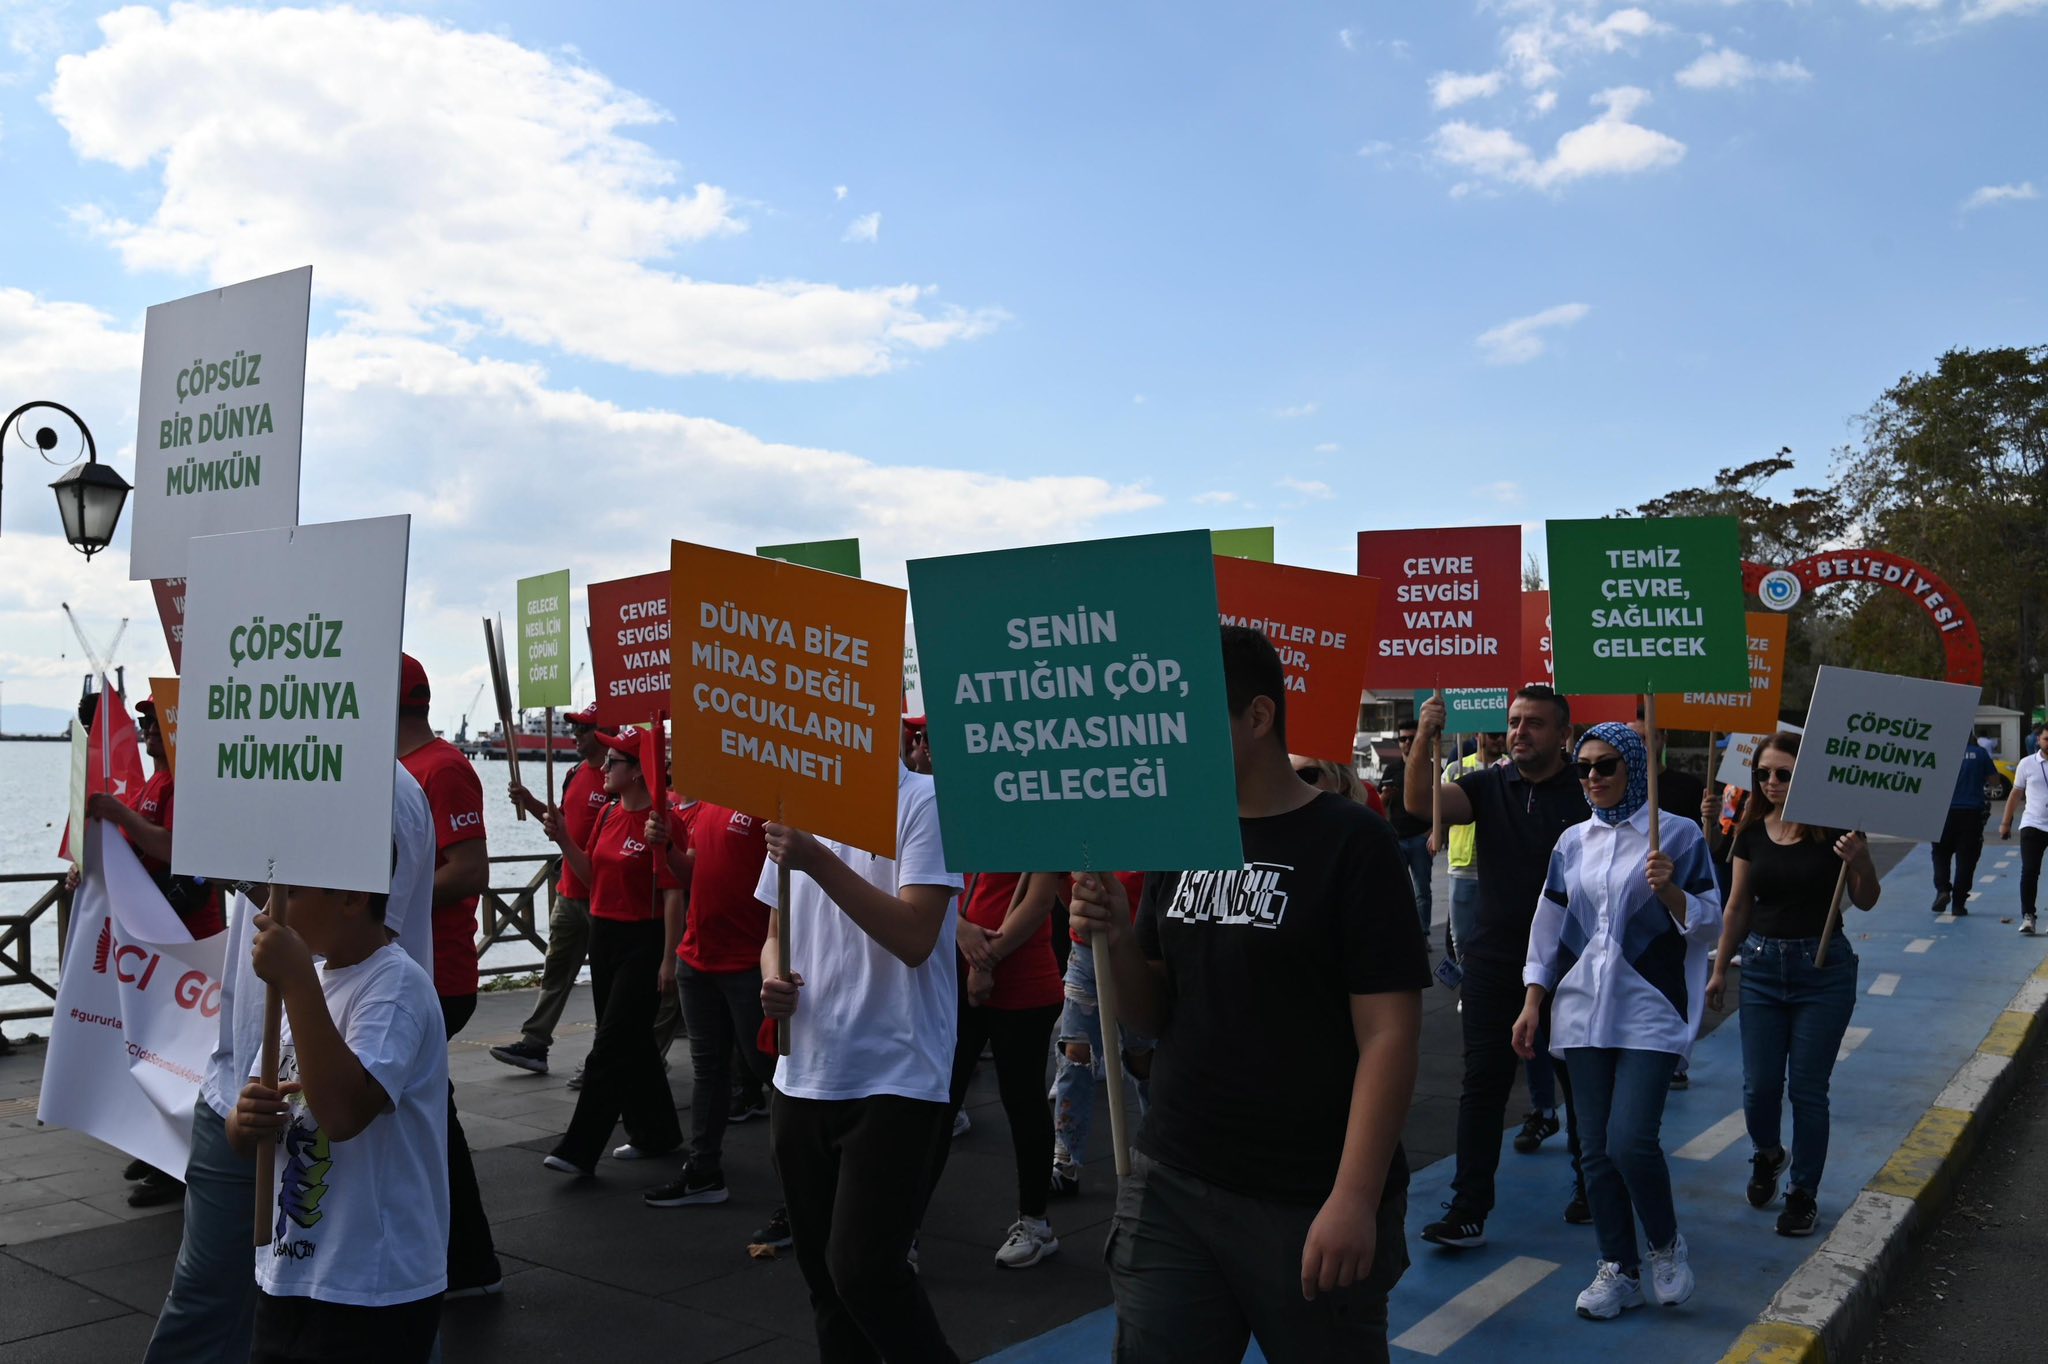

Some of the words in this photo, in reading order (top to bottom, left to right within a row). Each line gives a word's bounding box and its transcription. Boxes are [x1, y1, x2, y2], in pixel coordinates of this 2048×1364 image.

[176, 350, 261, 404] ÇÖPSÜZ
[160, 411, 193, 449] BİR
[198, 403, 273, 443] DÜNYA
[166, 450, 261, 496] MÜMKÜN
[1403, 557, 1473, 578] ÇEVRE
[1606, 545, 1681, 569] TEMİZ
[1397, 579, 1479, 602] SEVGİSİ
[1601, 578, 1690, 602] ÇEVRE,
[1817, 559, 1963, 632] BELEDİYESİ
[527, 596, 559, 615] GELECEK
[620, 599, 666, 623] ÇEVRE
[1591, 604, 1703, 628] SAĞLIKLI
[525, 619, 545, 638] NESİL
[617, 619, 671, 646] SEVGİSİ
[700, 601, 796, 649] DÜNYA
[805, 624, 869, 667] BİZE
[1007, 605, 1117, 650] SENİN
[1218, 613, 1316, 645] MARİTLER
[1320, 630, 1347, 649] DE
[1403, 611, 1473, 629] VATAN
[230, 613, 343, 668] ÇÖPSÜZ
[529, 639, 558, 661] ÇÖPÜNÜ
[1378, 634, 1498, 657] SEVGİSİDİR
[1593, 636, 1706, 658] GELECEK
[1746, 634, 1769, 651] İZE
[529, 664, 548, 683] ÇÖPE
[549, 664, 558, 680] AT
[623, 649, 670, 670] VATAN
[609, 671, 671, 697] SEVGİSİD
[692, 640, 777, 685] MİRAS
[785, 663, 876, 717] DEĞİL,
[954, 659, 1094, 705] ATTIĞIN
[1104, 653, 1189, 701] ÇÖP,
[208, 676, 252, 720] BİR
[259, 674, 360, 720] DÜNYA
[1453, 696, 1508, 711] GELECEĞİ
[1683, 691, 1752, 708] EMANETİ
[693, 683, 873, 753] ÇOCUKLARIN
[1847, 712, 1932, 742] ÇÖPSÜZ
[964, 711, 1188, 757] BAŞKASININ
[218, 735, 342, 781] MÜMKÜN
[721, 728, 842, 785] EMANETİ
[1825, 736, 1861, 759] BİR
[1865, 742, 1937, 770] DÜNYA
[994, 757, 1167, 802] GELECEĞİ
[1827, 765, 1922, 795] MÜMKÜN
